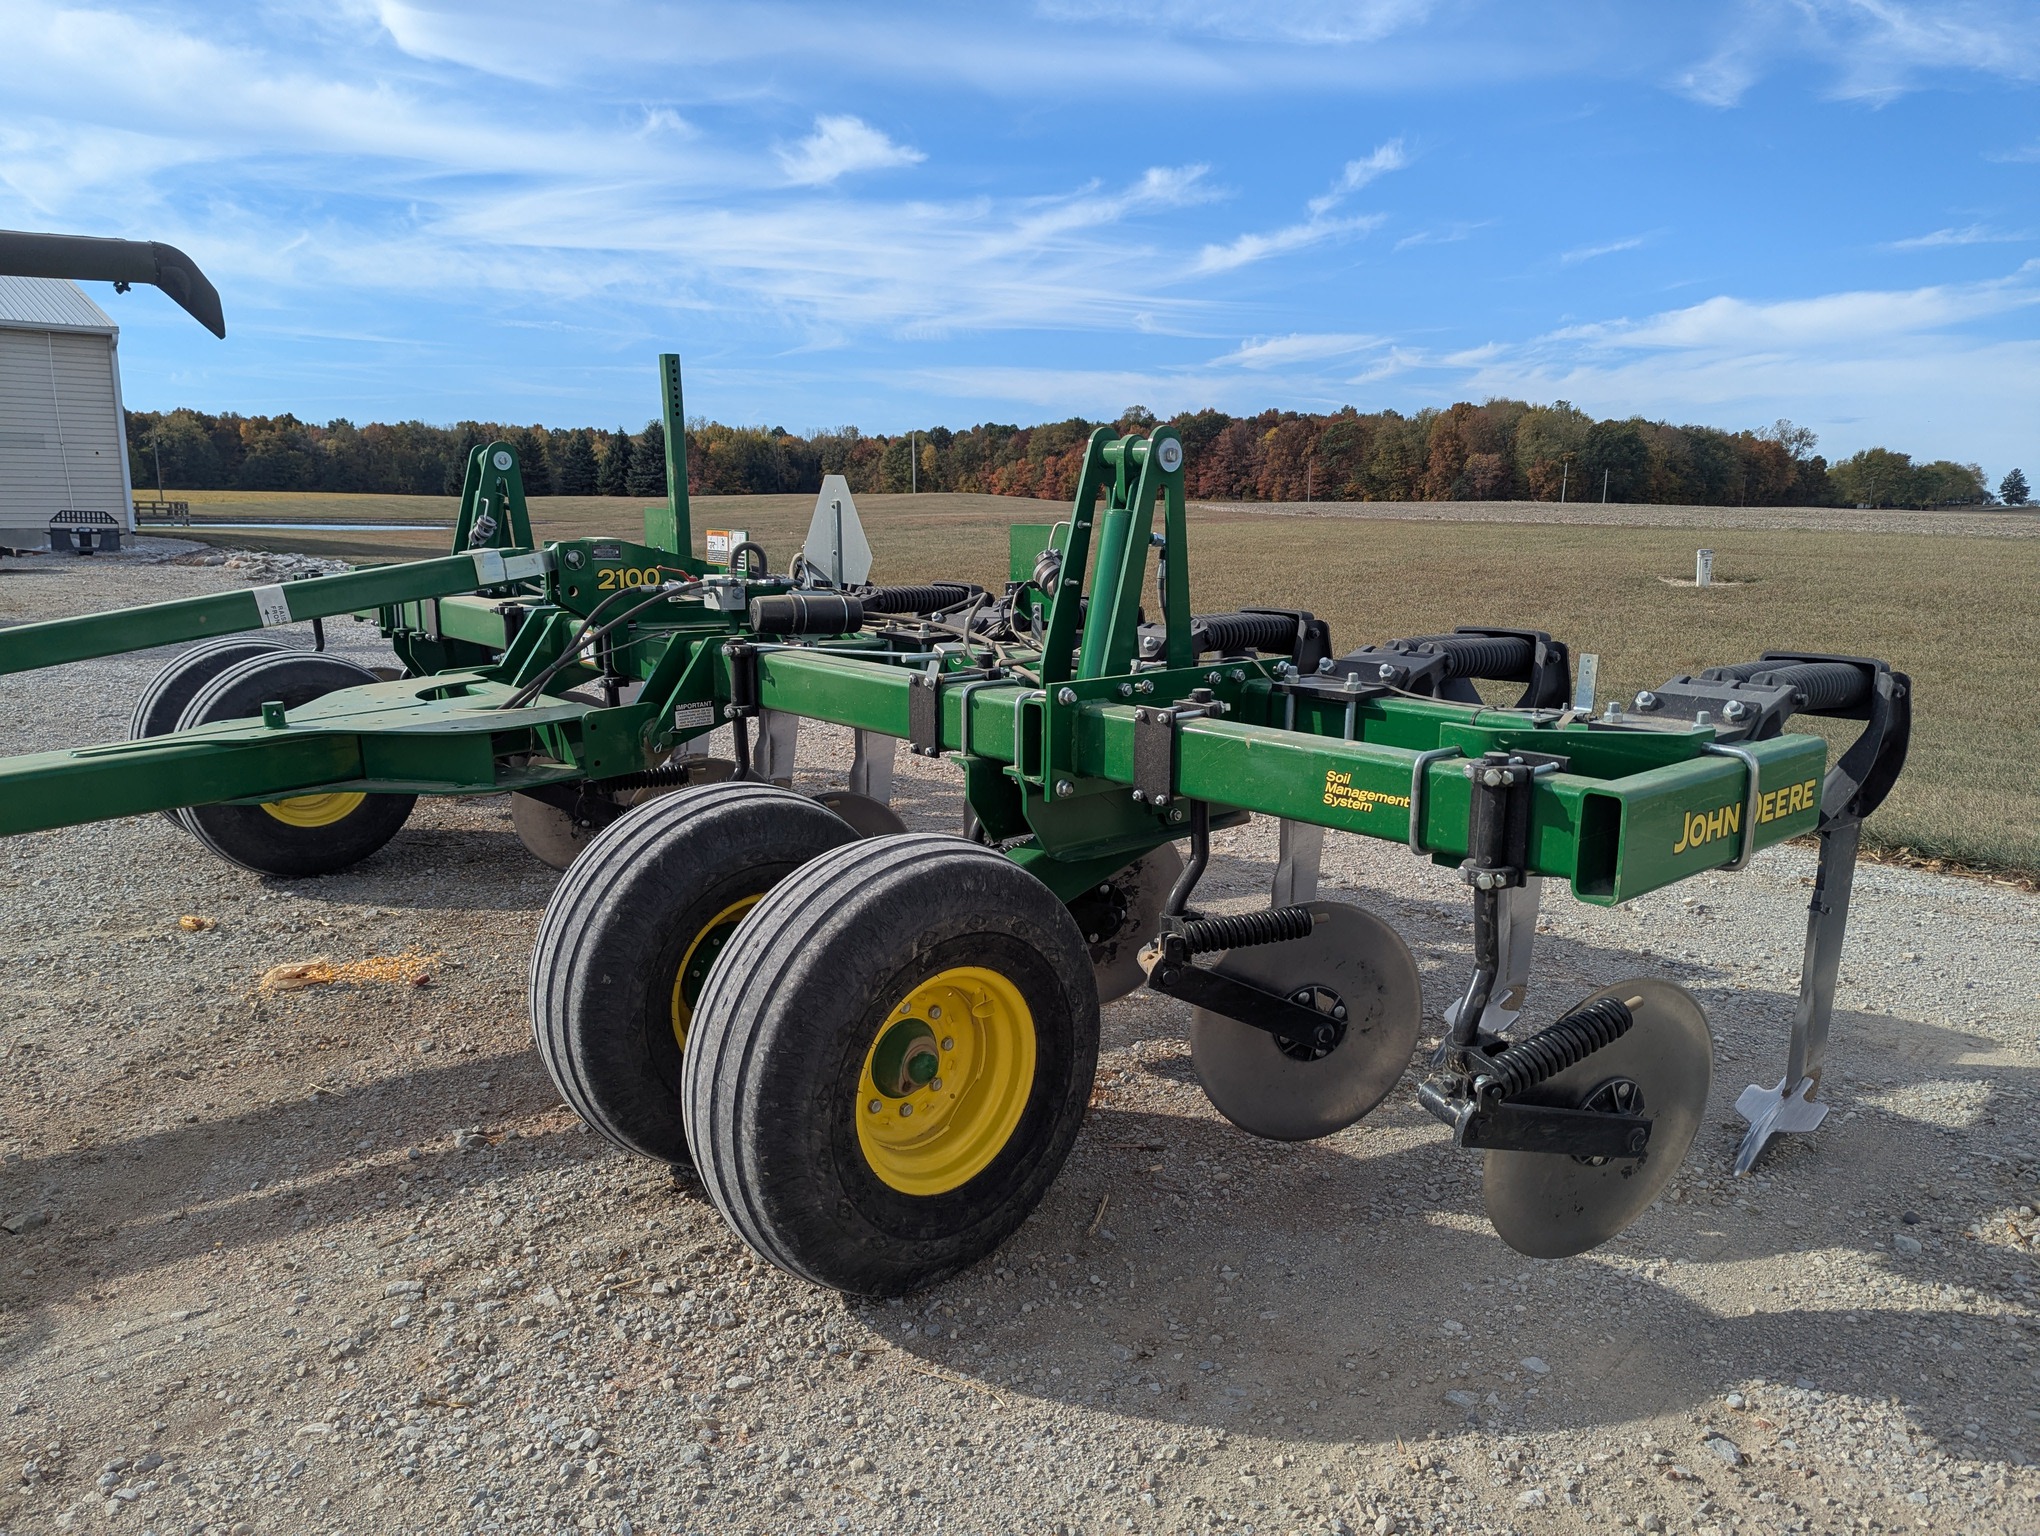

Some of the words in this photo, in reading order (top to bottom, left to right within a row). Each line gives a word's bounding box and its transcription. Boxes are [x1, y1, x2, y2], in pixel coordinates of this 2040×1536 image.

[597, 567, 661, 590] 2100
[270, 605, 281, 625] FRON
[676, 701, 712, 711] IMPORTANT
[1326, 770, 1352, 785] Soil
[1323, 793, 1373, 812] System
[1325, 782, 1410, 808] Management
[1673, 802, 1741, 855] JOHN
